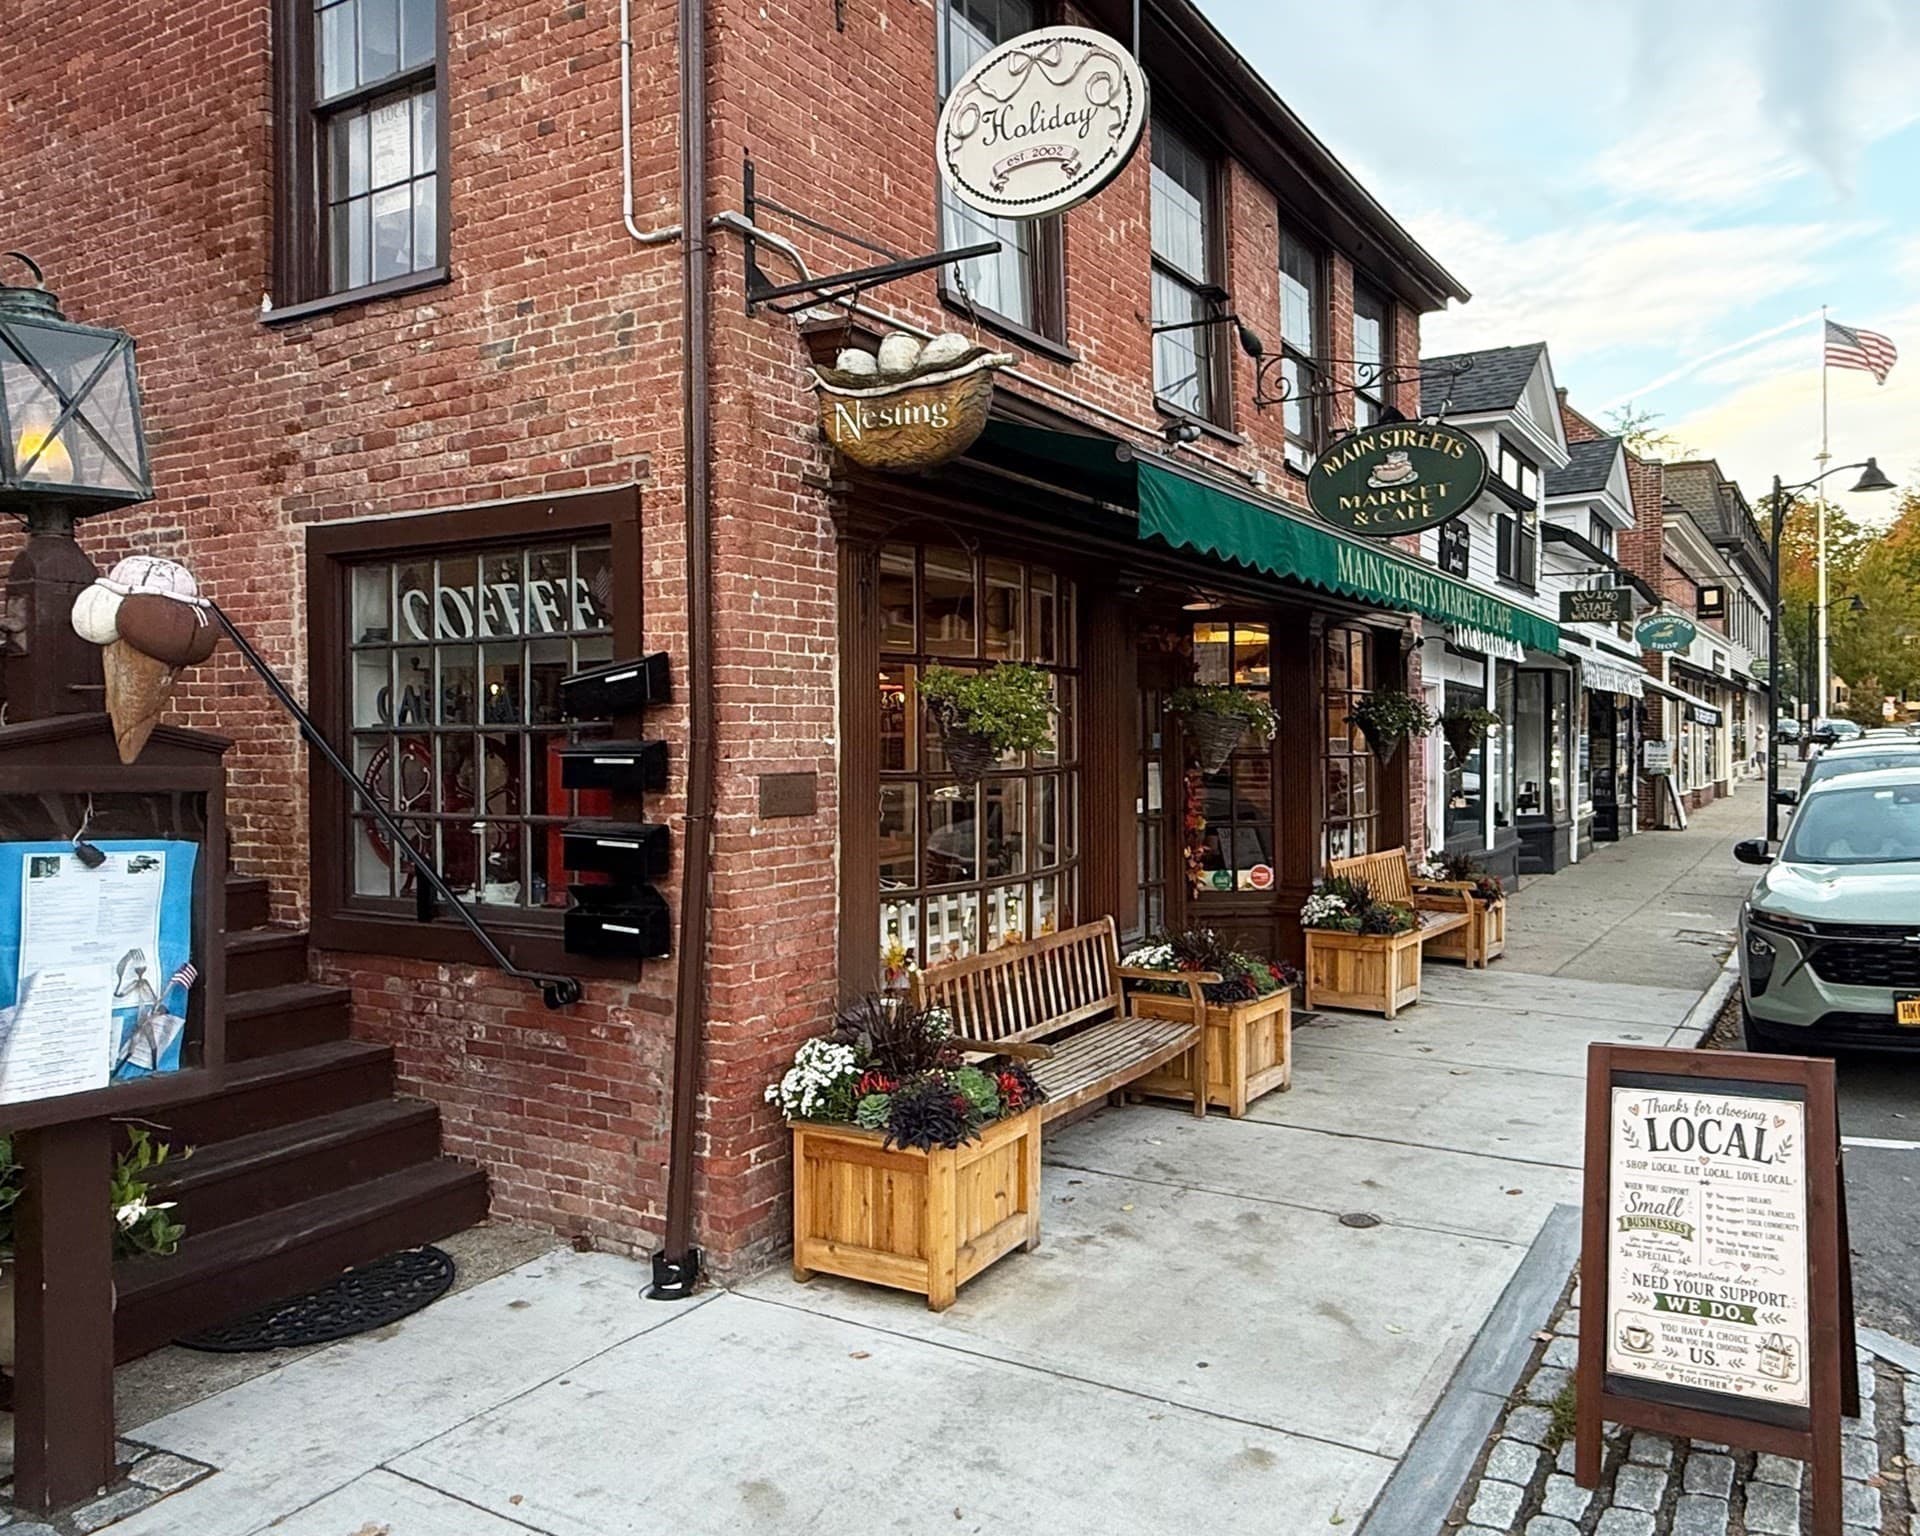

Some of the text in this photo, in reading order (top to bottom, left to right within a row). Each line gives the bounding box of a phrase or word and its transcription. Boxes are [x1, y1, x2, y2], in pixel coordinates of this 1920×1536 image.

[982, 101, 1098, 146] Holiday
[1032, 146, 1064, 158] 2002
[835, 400, 949, 442] Nesting
[1322, 429, 1467, 477] MAIN STREETS
[1339, 483, 1453, 510] MARKET
[1353, 504, 1437, 526] & CAFE
[1337, 544, 1513, 634] MAIN STREETS MARKET & CAFE
[1575, 601, 1613, 612] ESTATE
[1902, 1003, 1920, 1019] HK
[1642, 1097, 1767, 1125] Thanks for choosing
[1644, 1116, 1774, 1165] LOCAL
[1626, 1160, 1648, 1170] SHOP
[1684, 1166, 1700, 1176] EAT
[1736, 1171, 1759, 1182] LOVE
[1624, 1191, 1684, 1218] Small
[1626, 1217, 1686, 1234] BUSINESSES
[1673, 1268, 1730, 1284] corporations
[1632, 1272, 1791, 1309] NEED YOUR SUPPORT.
[1664, 1295, 1746, 1321] WE DO.
[1660, 1323, 1678, 1333] YOU
[1681, 1325, 1704, 1337] HAVE
[1708, 1328, 1714, 1339] A
[1689, 1347, 1720, 1367] US.
